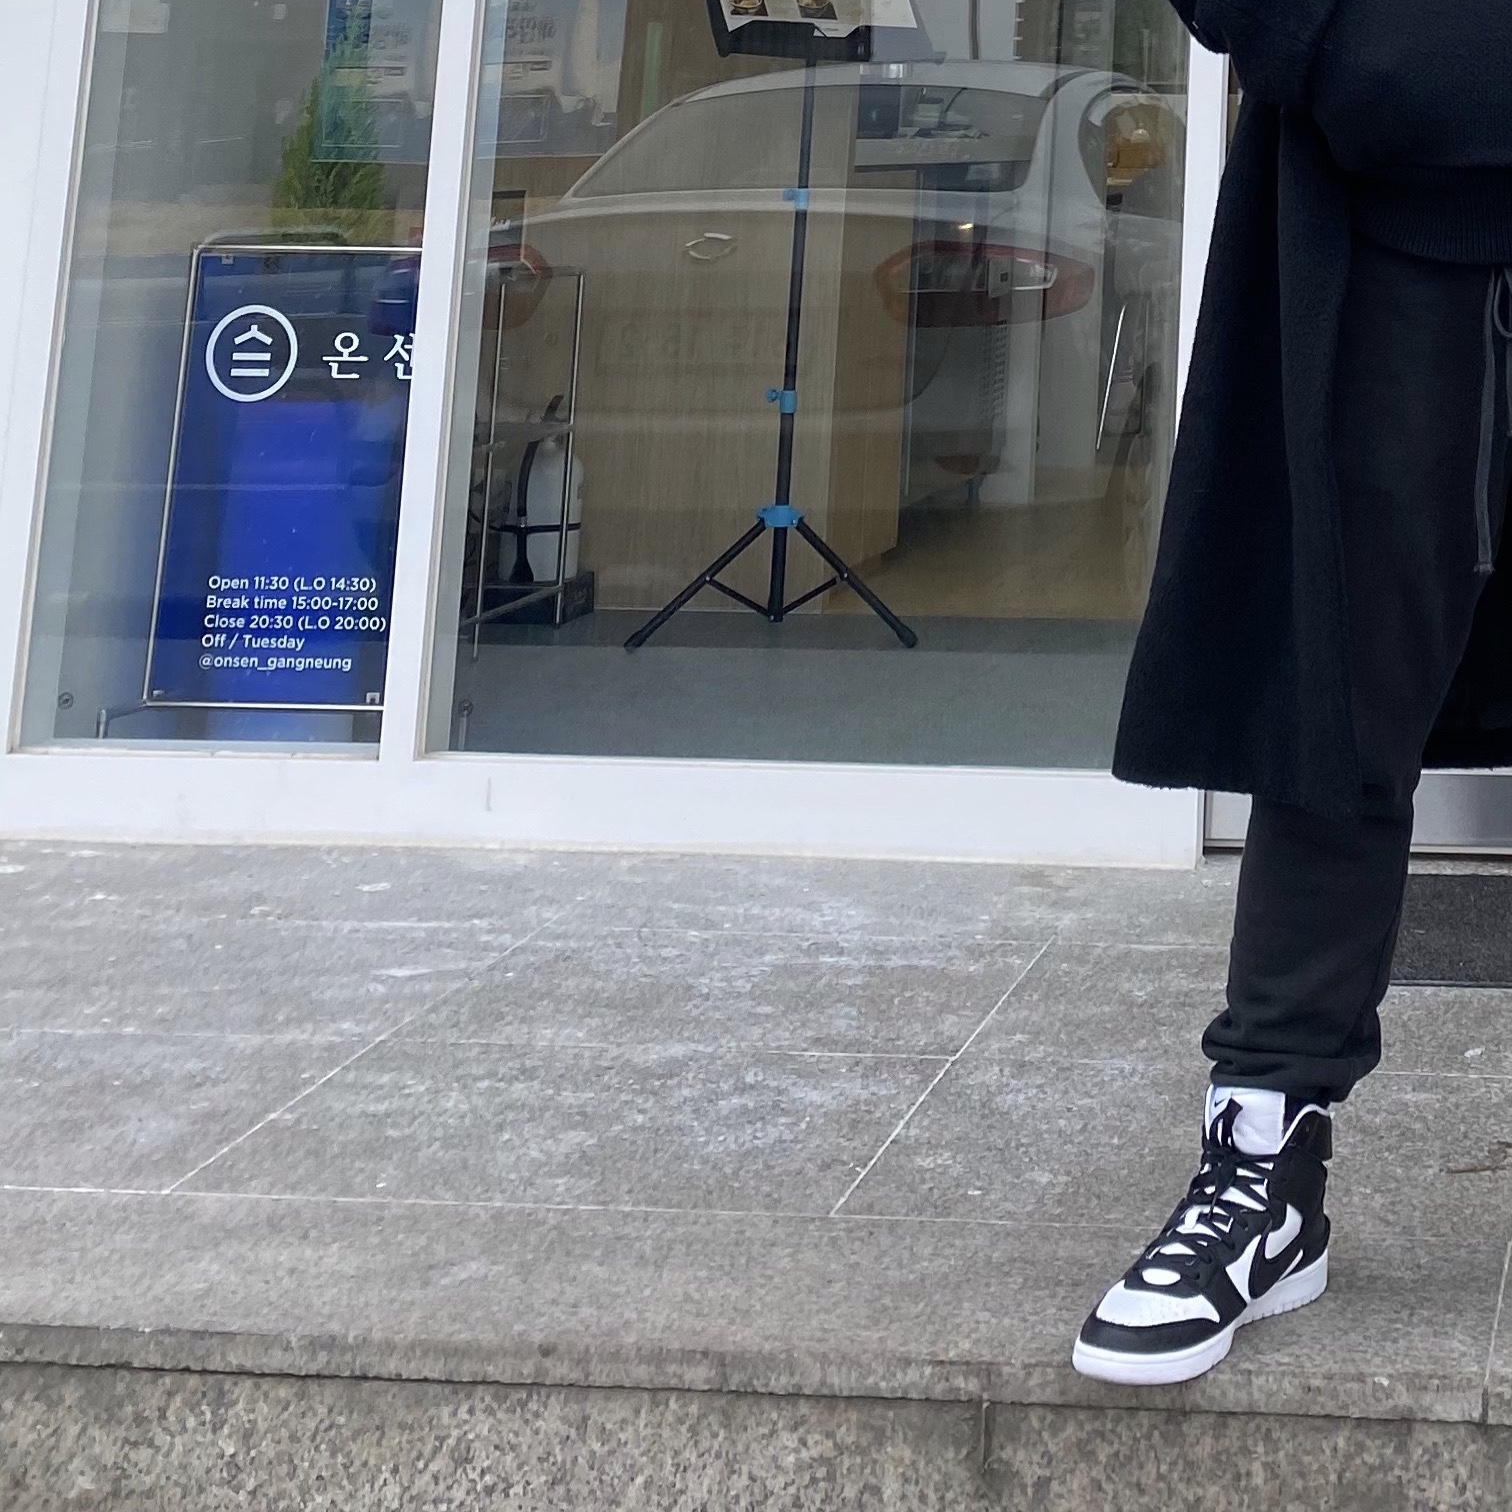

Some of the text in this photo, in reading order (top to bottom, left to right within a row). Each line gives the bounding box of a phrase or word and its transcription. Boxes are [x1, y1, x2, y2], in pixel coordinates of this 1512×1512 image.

[208, 575, 377, 593] Open 11:30 (L.O 14:30)
[205, 594, 379, 611] Break time 15:00-17:00
[203, 613, 387, 632] Close 20:30 (L.O 20:00)
[201, 633, 227, 648] Off
[242, 634, 305, 651] Tuesday
[199, 652, 352, 672] @onsen_gangneung
